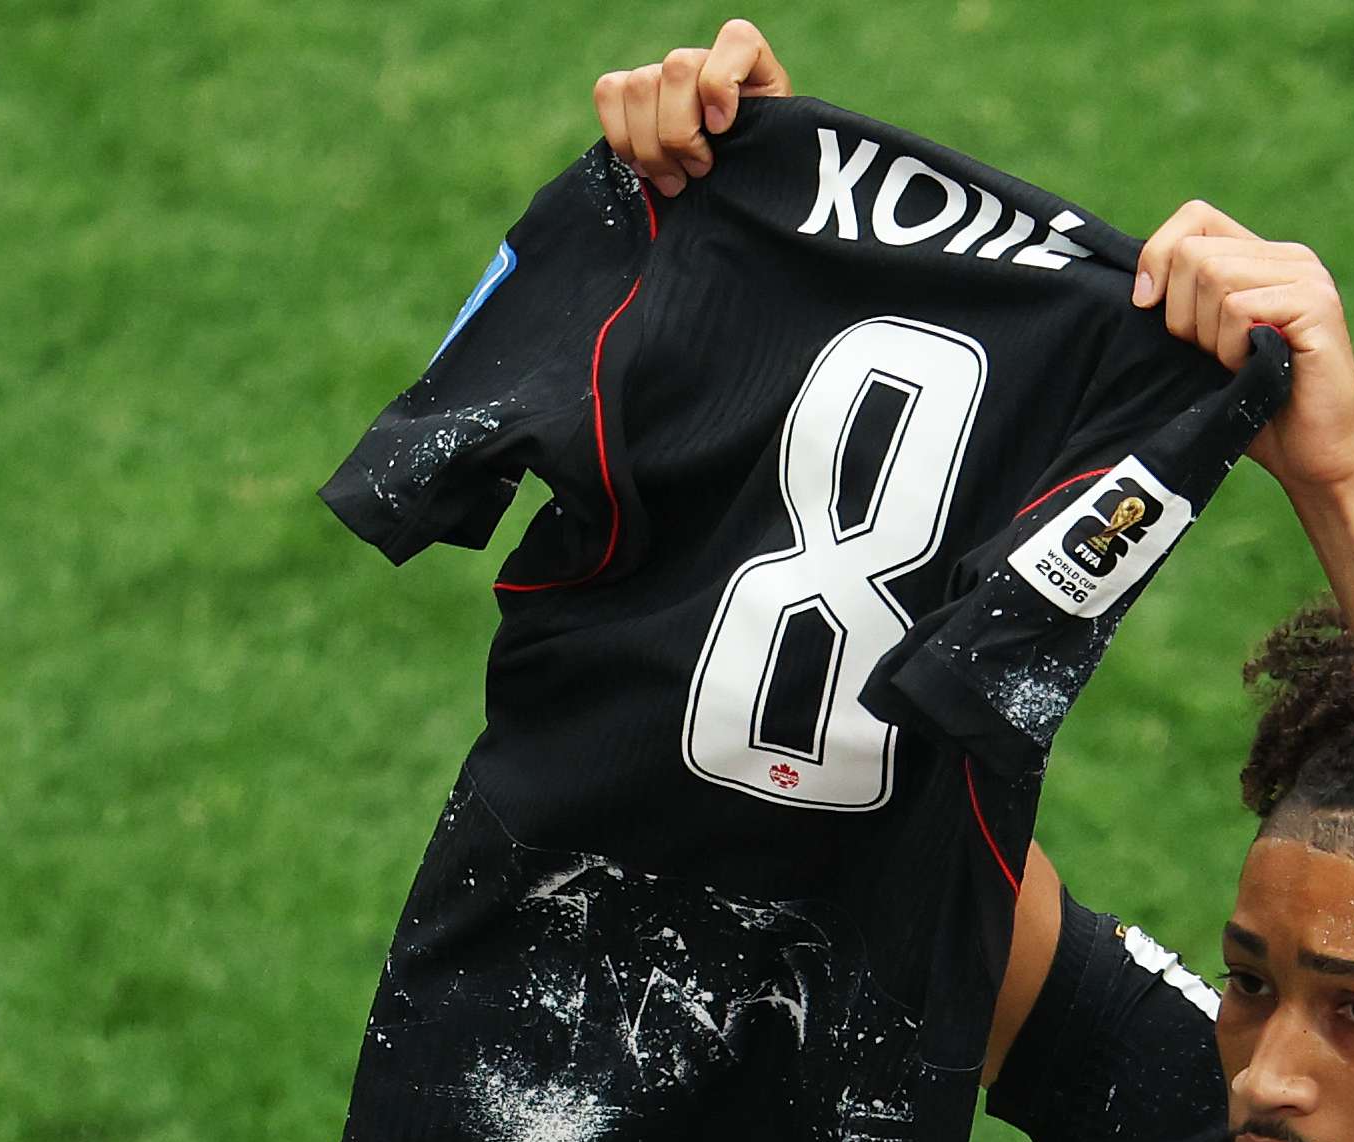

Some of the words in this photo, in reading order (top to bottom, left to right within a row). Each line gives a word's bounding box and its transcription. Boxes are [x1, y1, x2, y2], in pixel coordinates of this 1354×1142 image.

[681, 315, 988, 812] 8
[1047, 549, 1080, 580] WORLD
[1078, 577, 1097, 591] CUP
[1074, 542, 1102, 569] FIFA
[1035, 559, 1089, 603] 2026
